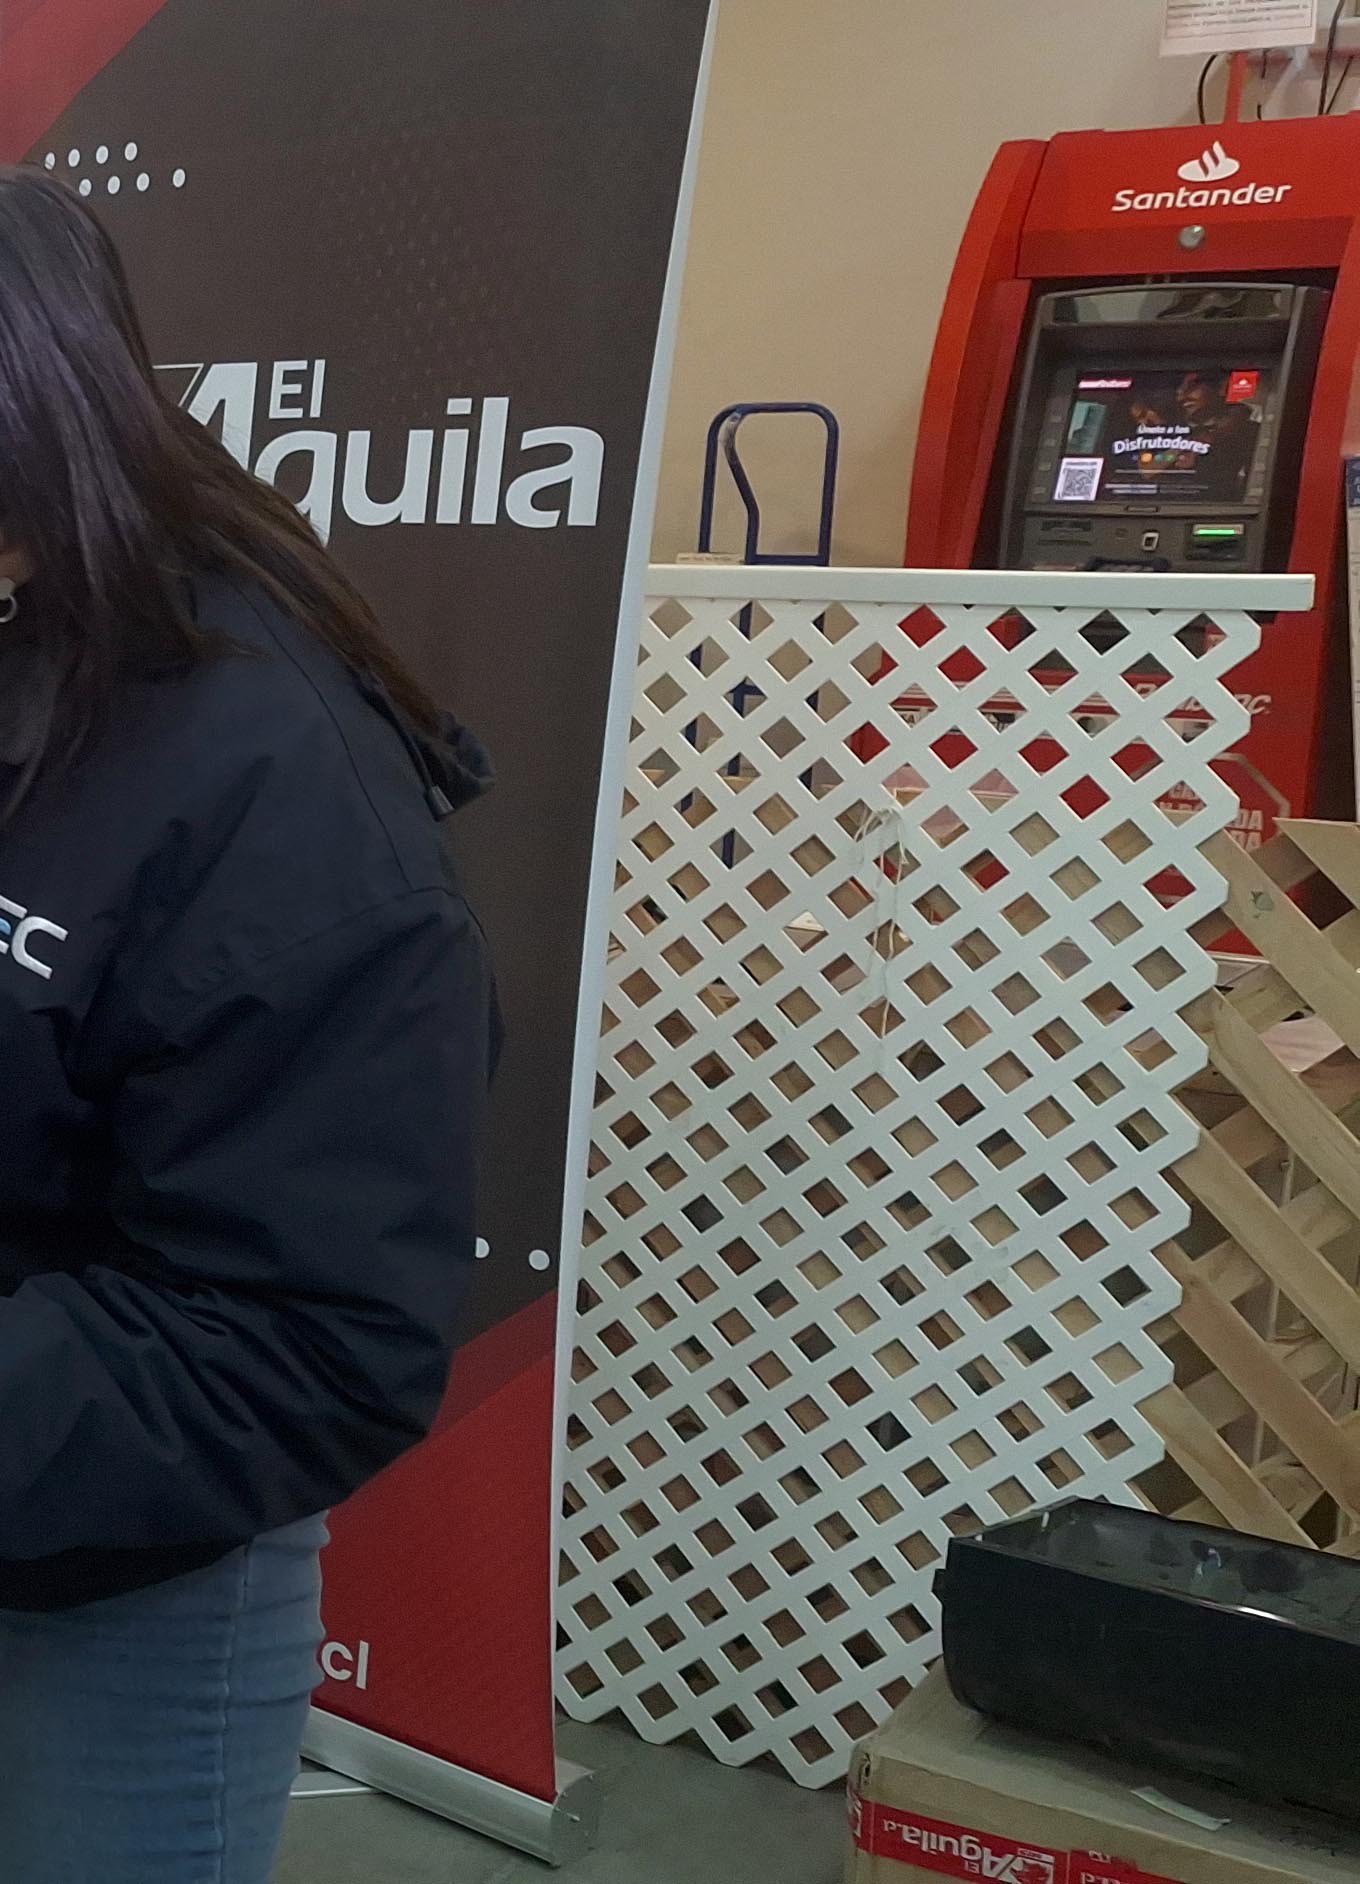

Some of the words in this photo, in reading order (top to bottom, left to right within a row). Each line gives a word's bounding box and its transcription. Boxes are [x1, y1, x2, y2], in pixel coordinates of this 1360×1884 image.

[1111, 183, 1292, 212] Santander
[269, 359, 326, 419] El
[1113, 436, 1210, 454] Disfrutadores
[321, 1640, 369, 1690] cl
